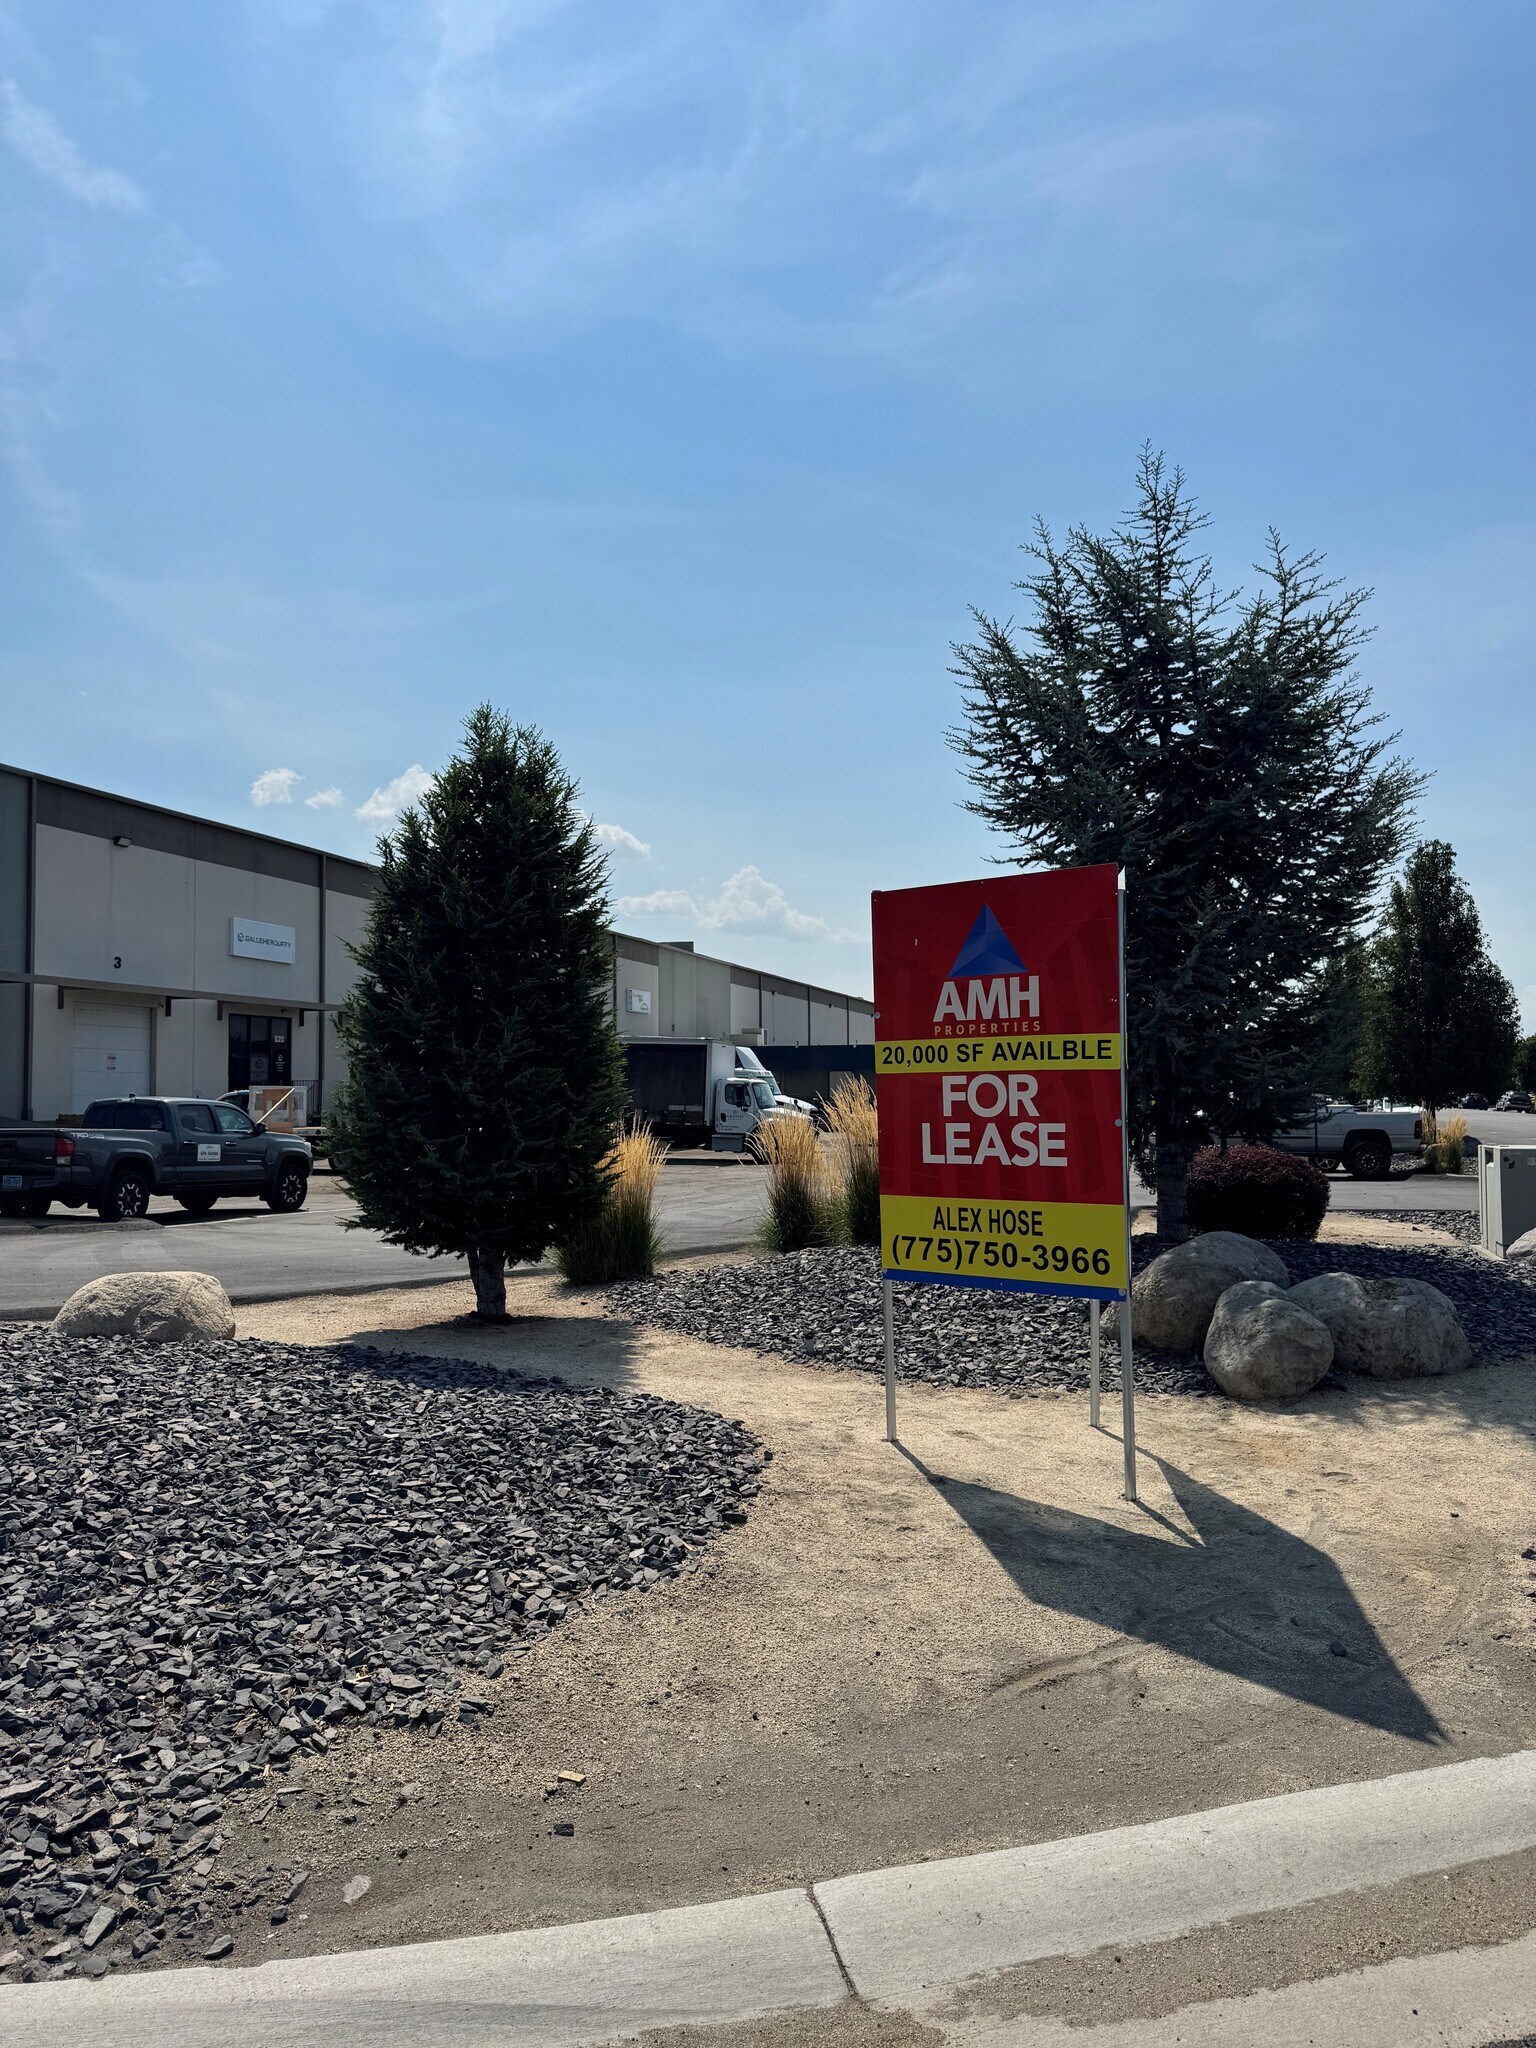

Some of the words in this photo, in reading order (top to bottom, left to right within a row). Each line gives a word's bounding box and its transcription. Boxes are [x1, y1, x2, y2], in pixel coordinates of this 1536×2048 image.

[113, 956, 122, 969] 3
[933, 975, 1040, 1023] AMH
[274, 1035, 285, 1043] 820
[934, 1021, 1041, 1036] PROPERTIES
[882, 1045, 948, 1067] 20,000
[956, 1043, 984, 1062] SF
[991, 1039, 1112, 1062] AVAILBLE
[942, 1073, 1040, 1118] FOR
[921, 1122, 1068, 1167] LEASE
[933, 1206, 982, 1233] ALEX
[988, 1209, 1044, 1236] HOSE
[892, 1234, 1111, 1276] (775)750-3966
